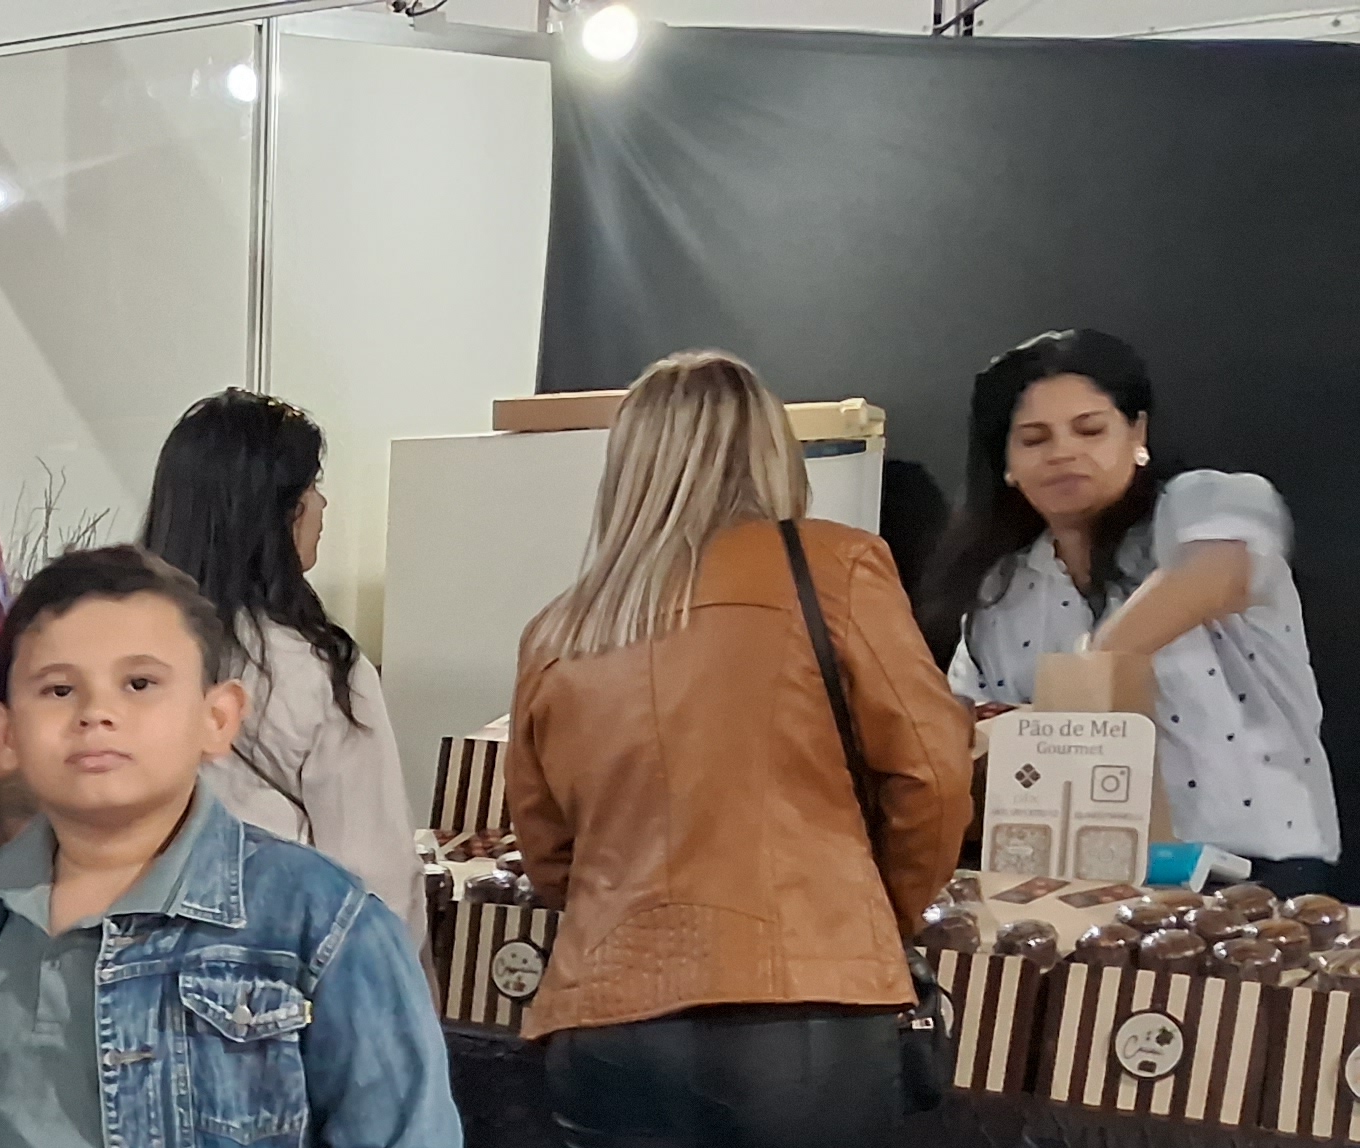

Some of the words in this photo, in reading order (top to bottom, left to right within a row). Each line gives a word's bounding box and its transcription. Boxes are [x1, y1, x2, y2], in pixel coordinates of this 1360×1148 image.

[1018, 718, 1054, 737] Pão
[1059, 719, 1084, 737] de
[1091, 719, 1127, 738] Mel
[1036, 740, 1104, 755] Gourmet
